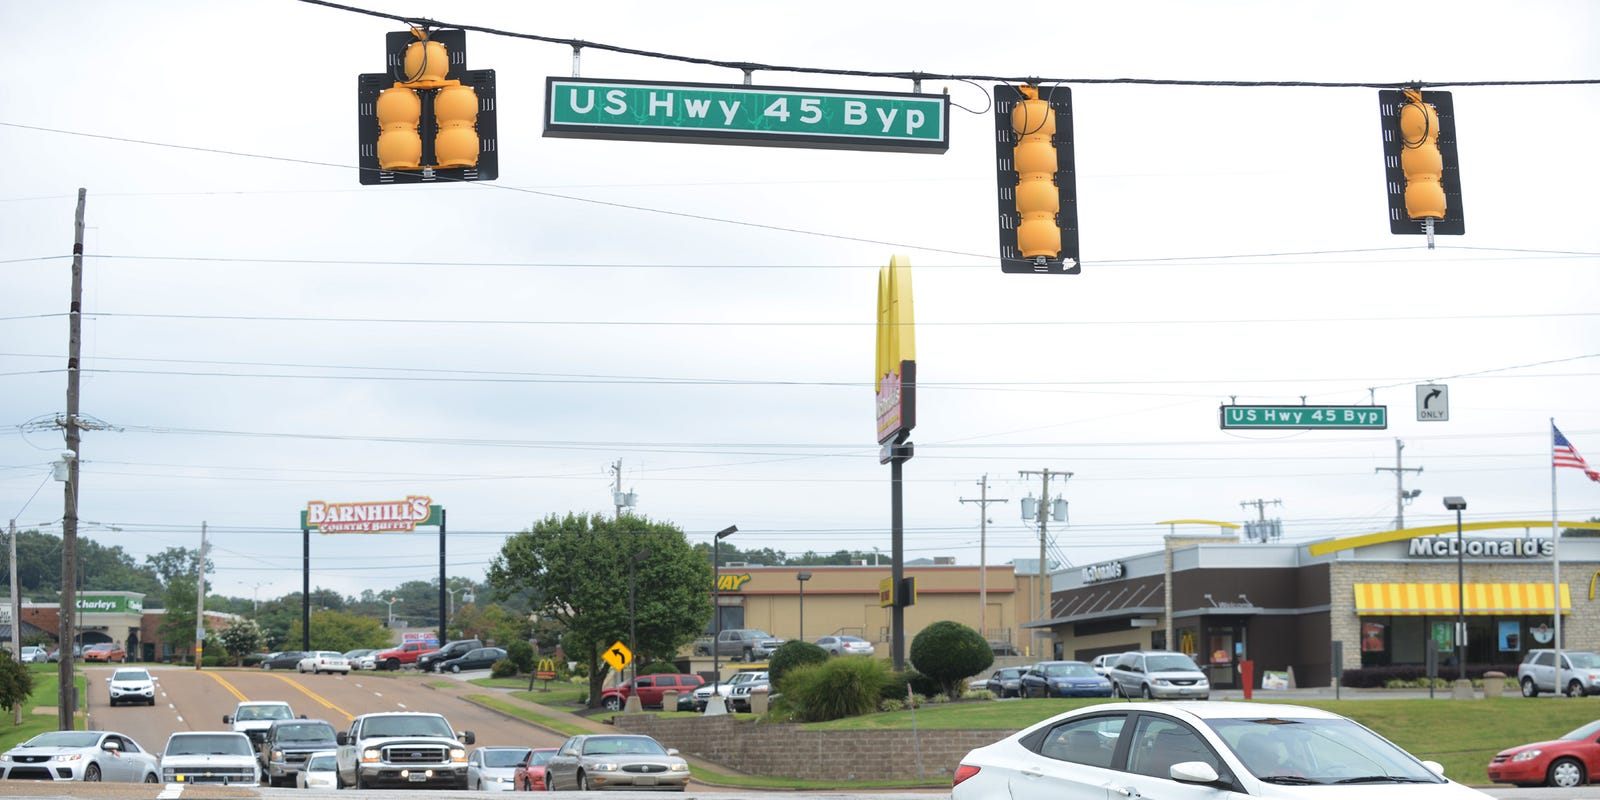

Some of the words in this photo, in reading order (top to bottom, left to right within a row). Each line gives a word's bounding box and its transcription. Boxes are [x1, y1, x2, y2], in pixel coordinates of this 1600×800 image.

[569, 88, 627, 116] US
[648, 92, 741, 125] Hwy
[763, 98, 823, 124] 45
[843, 103, 926, 135] Byp
[1232, 409, 1257, 422] US
[1264, 409, 1303, 424] Hwy
[1311, 409, 1337, 422] 45
[1344, 409, 1378, 424] Byp
[1421, 411, 1444, 419] ONLY
[309, 498, 429, 523] BARNHILL'S
[320, 522, 370, 533] COUNTRY
[1408, 538, 1555, 557] McDonald's
[76, 600, 117, 610] Charleys
